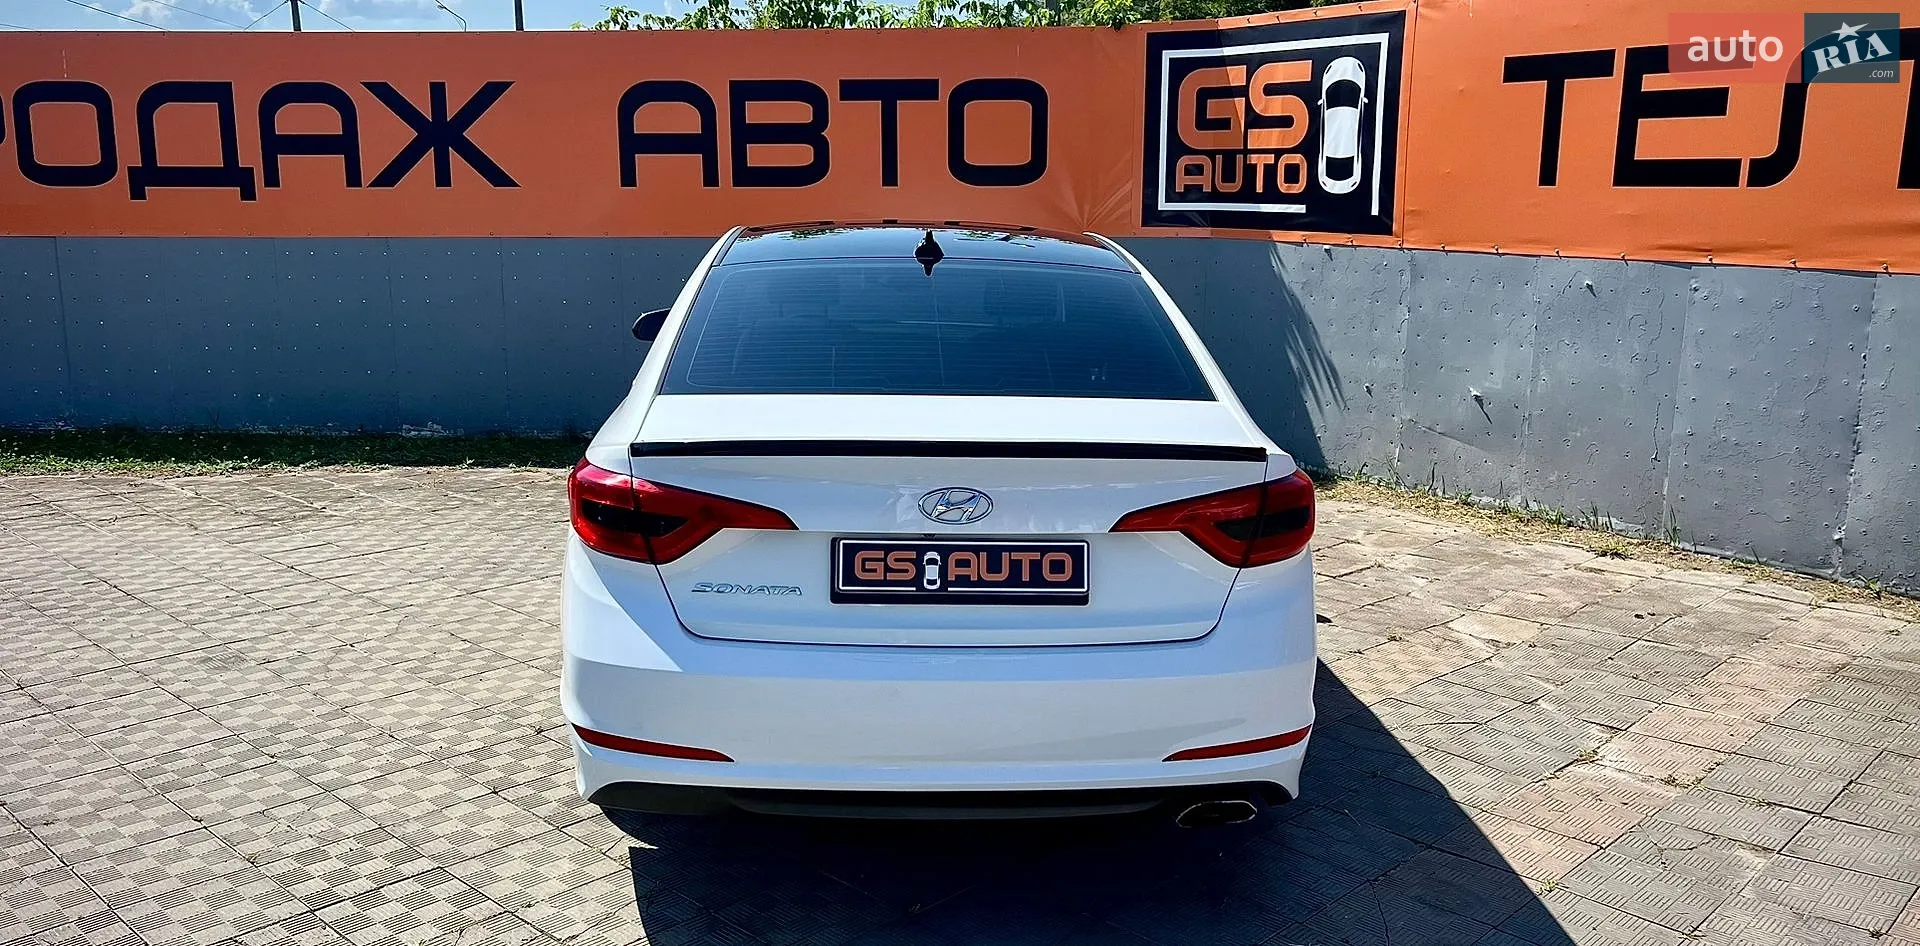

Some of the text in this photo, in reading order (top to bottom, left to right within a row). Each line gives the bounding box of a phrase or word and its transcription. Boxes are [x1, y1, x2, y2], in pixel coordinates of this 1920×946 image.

[1177, 60, 1312, 150] GS
[0, 78, 1049, 202] ОДАЖ АВТО
[1175, 153, 1308, 194] AUTO
[854, 551, 1073, 582] GS AUTO
[691, 582, 803, 596] SONATA
